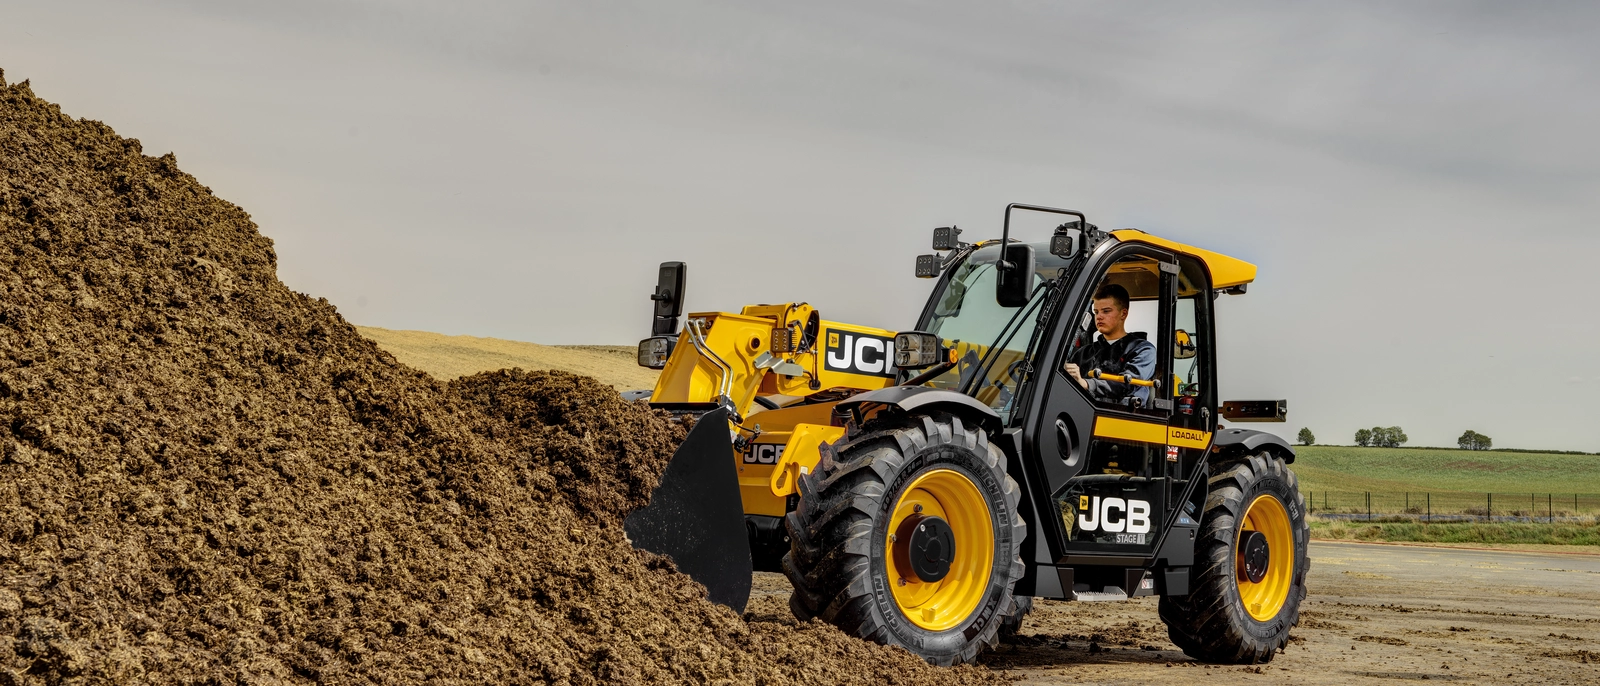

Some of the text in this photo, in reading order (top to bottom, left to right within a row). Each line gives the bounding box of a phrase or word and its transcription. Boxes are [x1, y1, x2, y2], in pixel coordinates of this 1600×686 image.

[1172, 430, 1203, 442] LOADALL
[1078, 495, 1151, 534] JCB
[1116, 534, 1137, 544] STAGE
[971, 596, 999, 631] XMCL
